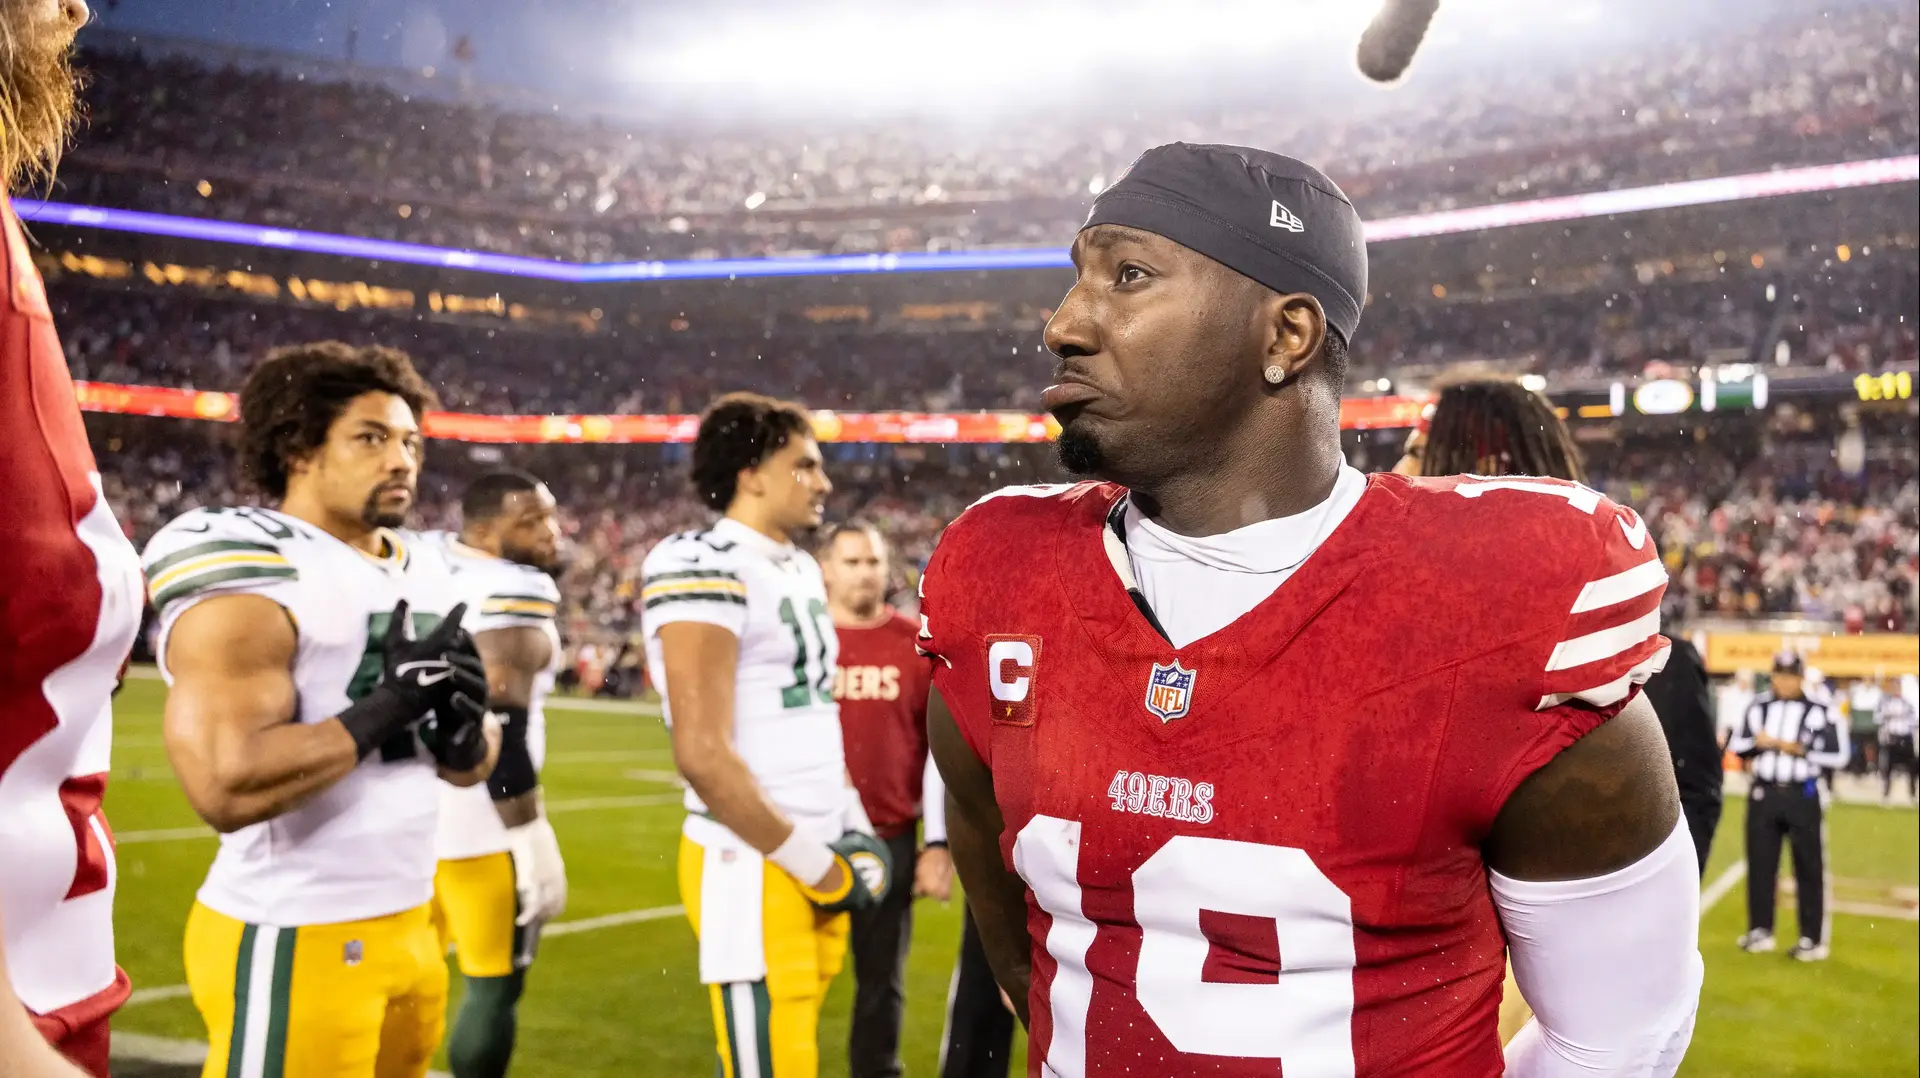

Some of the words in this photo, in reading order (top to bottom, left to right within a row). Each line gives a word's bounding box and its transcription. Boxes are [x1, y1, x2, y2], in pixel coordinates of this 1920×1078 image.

[989, 641, 1034, 702] C
[1151, 685, 1183, 712] NFL
[1107, 769, 1215, 824] 49ERS
[1012, 813, 1357, 1078] 19
